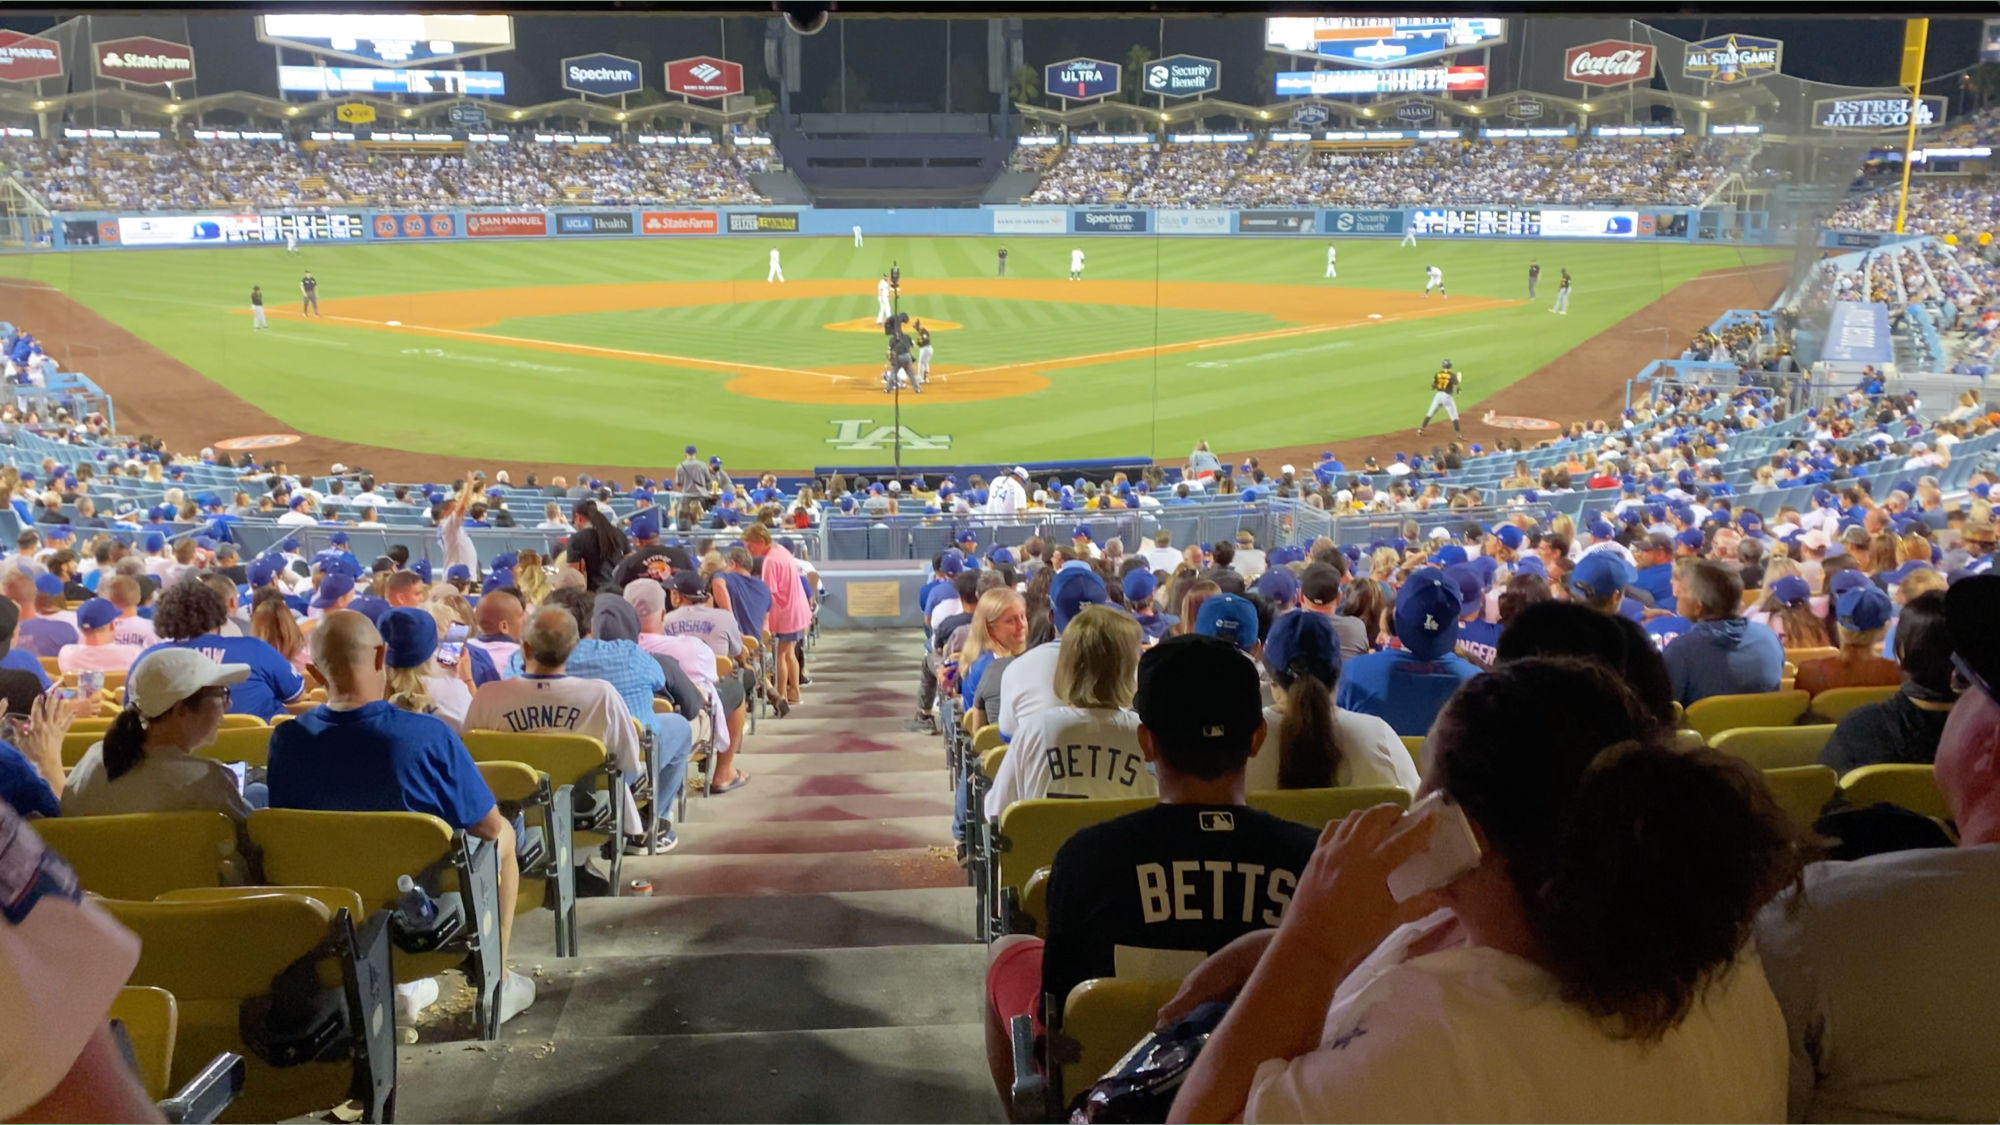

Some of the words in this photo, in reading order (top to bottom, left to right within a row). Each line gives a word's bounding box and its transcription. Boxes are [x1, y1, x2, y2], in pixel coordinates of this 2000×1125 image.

[1740, 51, 1776, 63] GAME
[569, 66, 632, 83] Spectrum
[1061, 70, 1103, 82] ULTRA
[1171, 65, 1212, 78] Security
[1171, 76, 1206, 88] Benefit
[1822, 113, 1909, 127] JALISCO
[479, 216, 501, 226] SAN
[502, 216, 543, 226] MANUEL
[566, 219, 589, 229] UCLA
[594, 217, 627, 229] Health
[1086, 213, 1132, 224] Spectrum
[1356, 212, 1390, 225] Security
[378, 222, 393, 232] 76
[406, 220, 421, 231] 76
[435, 220, 449, 231] 76
[825, 419, 952, 450] LA
[664, 620, 716, 636] KERSHAW
[503, 704, 581, 733] TURNER
[1046, 744, 1141, 787] BETTS
[1136, 860, 1299, 928] BETTS
